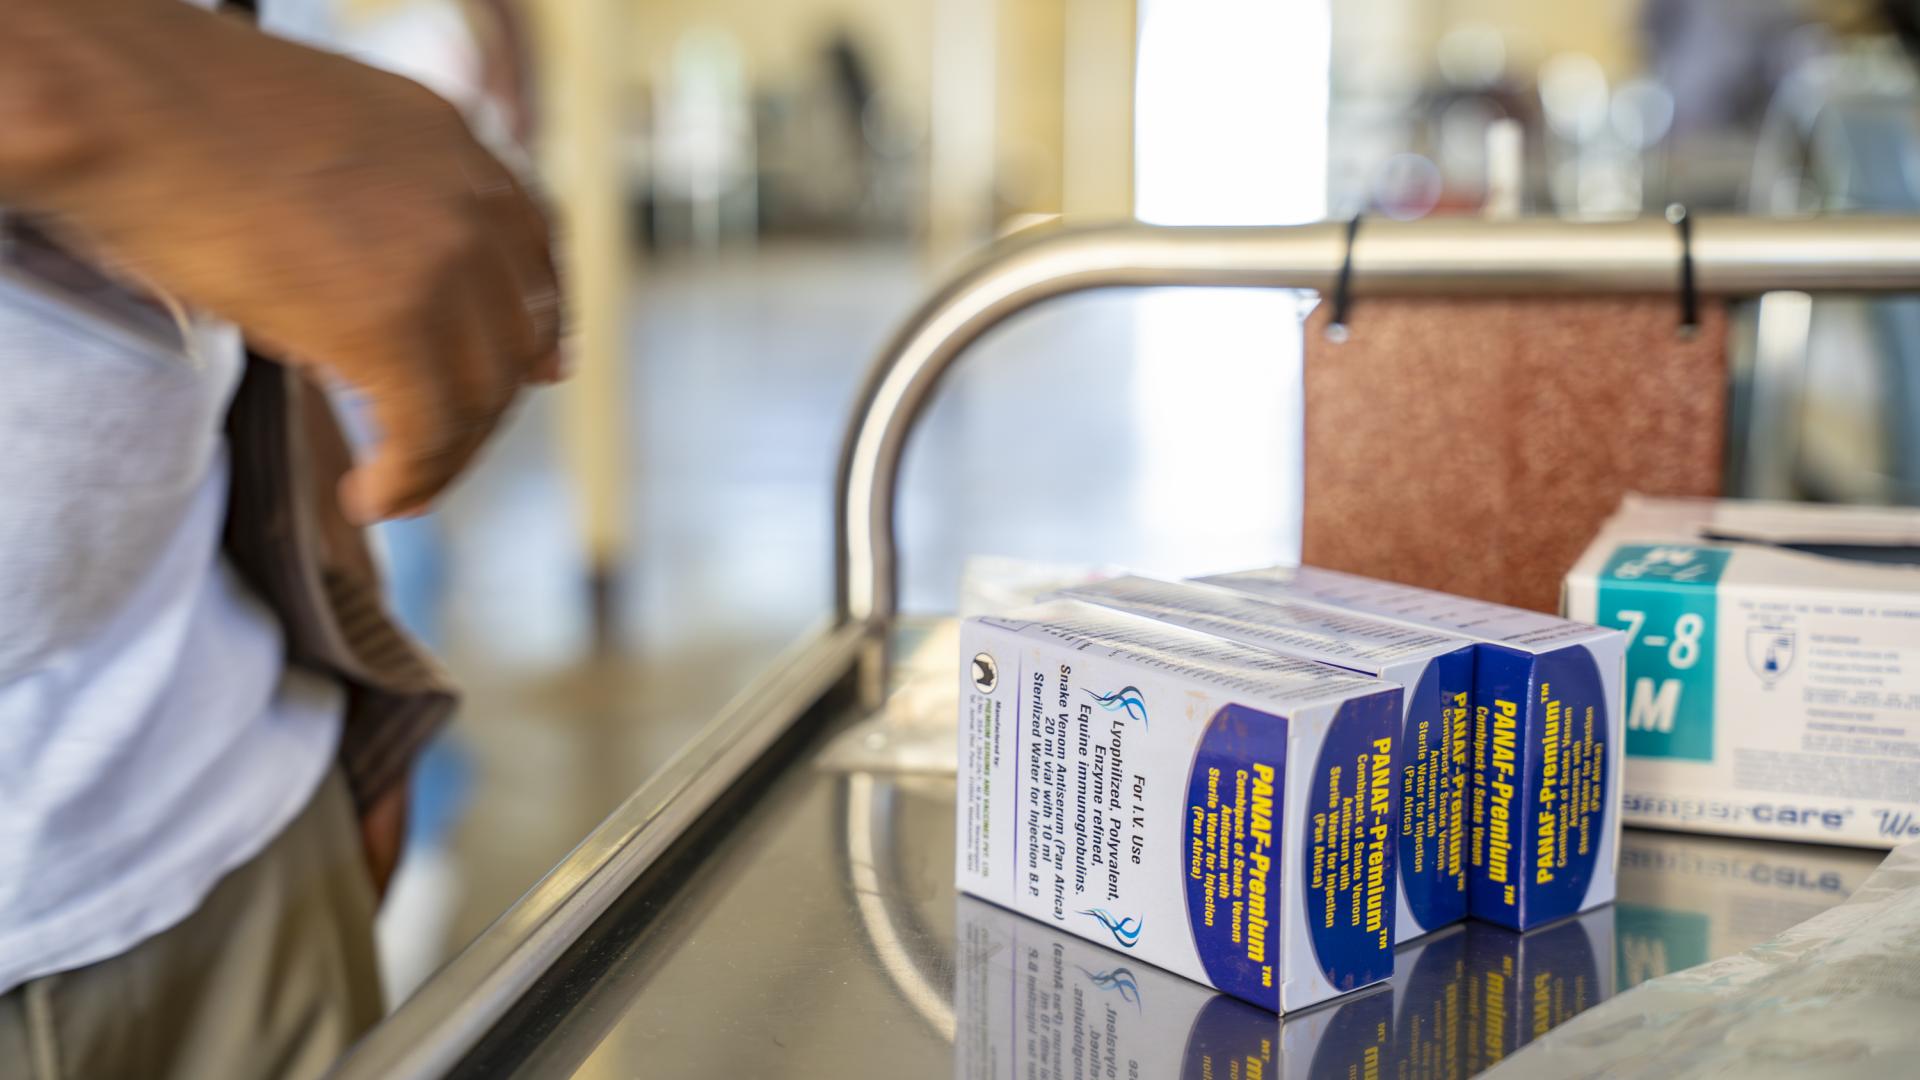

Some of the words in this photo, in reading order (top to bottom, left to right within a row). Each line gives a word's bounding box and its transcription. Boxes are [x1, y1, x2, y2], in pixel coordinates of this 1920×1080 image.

[1616, 609, 1705, 670] 7-8
[1032, 671, 1044, 738] Sterilized
[1059, 664, 1071, 708] Snake
[1628, 678, 1683, 734] M
[1045, 717, 1055, 736] 20
[1056, 713, 1069, 760] Venom
[1078, 703, 1092, 757] Equine
[1418, 721, 1429, 761] Sterile
[1440, 709, 1452, 775] Combipack
[1473, 706, 1488, 771] Combipack
[1562, 707, 1573, 747] Venom
[1583, 706, 1594, 757] Injection
[1031, 741, 1042, 783] Water
[1044, 739, 1055, 757] ml
[1109, 719, 1125, 812] Lyophilized,
[1561, 750, 1570, 786] Snake
[1573, 740, 1582, 766] with
[1043, 760, 1054, 786] vial
[1093, 744, 1106, 804] Enzyme
[1132, 774, 1145, 801] For
[1207, 767, 1220, 809] Sterile
[1329, 766, 1341, 808] Sterile
[1354, 753, 1368, 824] Combipack
[1403, 766, 1415, 793] (Pan
[1416, 763, 1427, 798] Water
[1427, 750, 1439, 810] Antiserum
[1440, 776, 1449, 790] of
[1474, 773, 1485, 786] of
[1582, 760, 1590, 777] for
[1030, 786, 1041, 807] for
[1043, 788, 1053, 818] with
[1055, 763, 1067, 835] Antiserum
[1234, 769, 1248, 840] Combipack
[1416, 800, 1426, 818] for
[1439, 791, 1448, 828] Snake
[1473, 787, 1485, 824] Snake
[1561, 786, 1568, 801] of
[1570, 767, 1581, 828] Antiserum
[1581, 778, 1590, 814] Water
[1043, 822, 1053, 843] 10
[1074, 760, 1089, 897] immunoglobulins.
[1132, 804, 1144, 829] I.V.
[1191, 805, 1204, 834] (Pan
[1206, 812, 1218, 851] Water
[1313, 813, 1326, 843] (Pan
[1327, 811, 1339, 847] Water
[1340, 797, 1353, 860] Antiserum
[1354, 825, 1364, 839] of
[1402, 796, 1414, 836] Africa)
[1427, 812, 1436, 838] with
[1557, 803, 1568, 868] Combipack
[1579, 815, 1589, 855] Sterile
[1028, 809, 1040, 869] Injection
[1042, 845, 1052, 863] ml
[1054, 837, 1066, 871] (Pan
[1091, 808, 1103, 867] refined,
[1131, 833, 1144, 865] Use
[1219, 804, 1232, 870] Antiserum
[1233, 840, 1245, 856] of
[1414, 819, 1425, 873] Injection
[1437, 830, 1447, 871] Venom
[1472, 826, 1484, 867] Venom
[1106, 817, 1122, 902] Polyvalent,
[1190, 837, 1203, 880] Africa)
[1205, 852, 1217, 871] for
[1232, 858, 1245, 898] Snake
[1311, 846, 1325, 889] Africa)
[1326, 849, 1338, 870] for
[1339, 862, 1350, 892] with
[1352, 840, 1365, 881] Snake
[1052, 876, 1065, 921] Africa)
[1204, 873, 1216, 927] Injection
[1219, 872, 1231, 899] with
[1325, 873, 1337, 928] Injection
[1351, 884, 1362, 927] Venom
[1231, 901, 1243, 943] Venom
